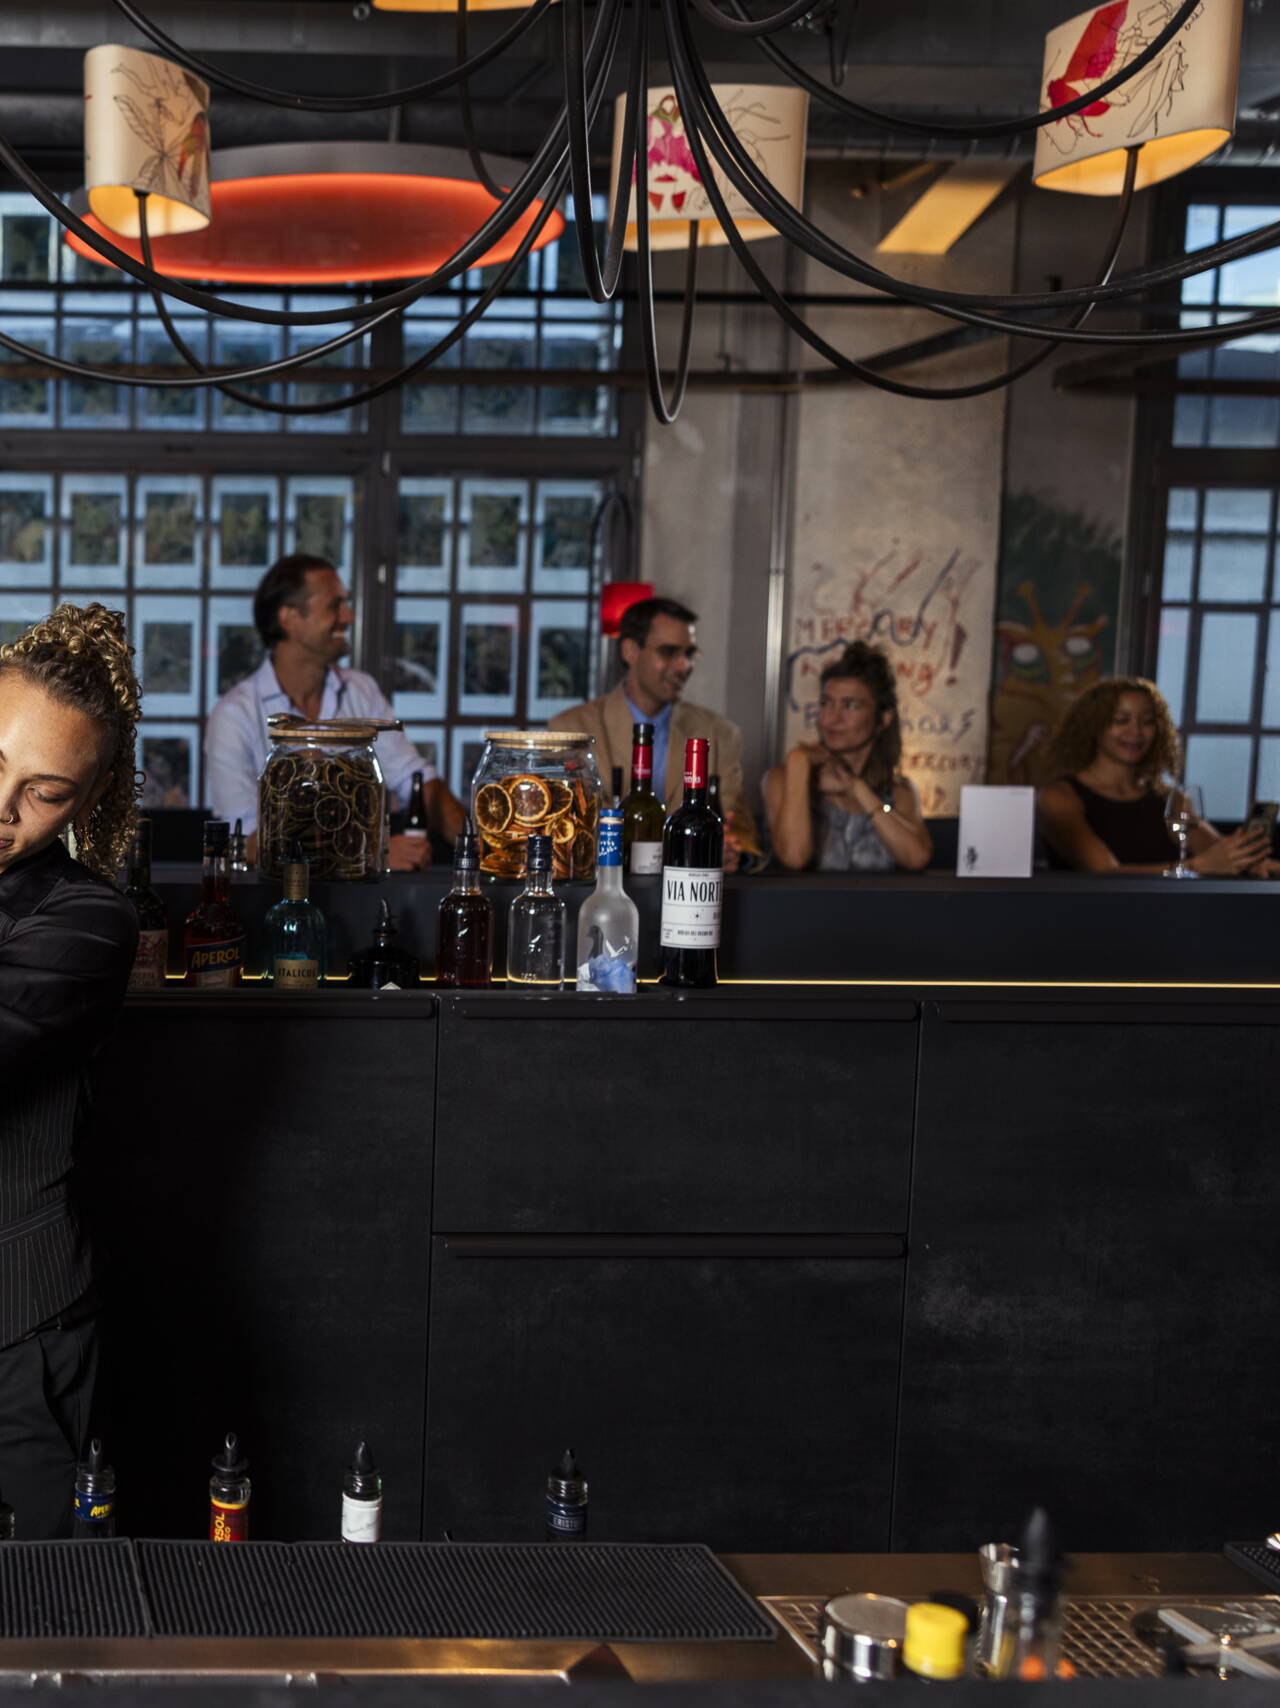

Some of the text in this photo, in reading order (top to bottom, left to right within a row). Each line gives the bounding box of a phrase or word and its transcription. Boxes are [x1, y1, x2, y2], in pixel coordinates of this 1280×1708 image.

[667, 880, 721, 902] VIA NORT
[191, 948, 241, 969] APEROL
